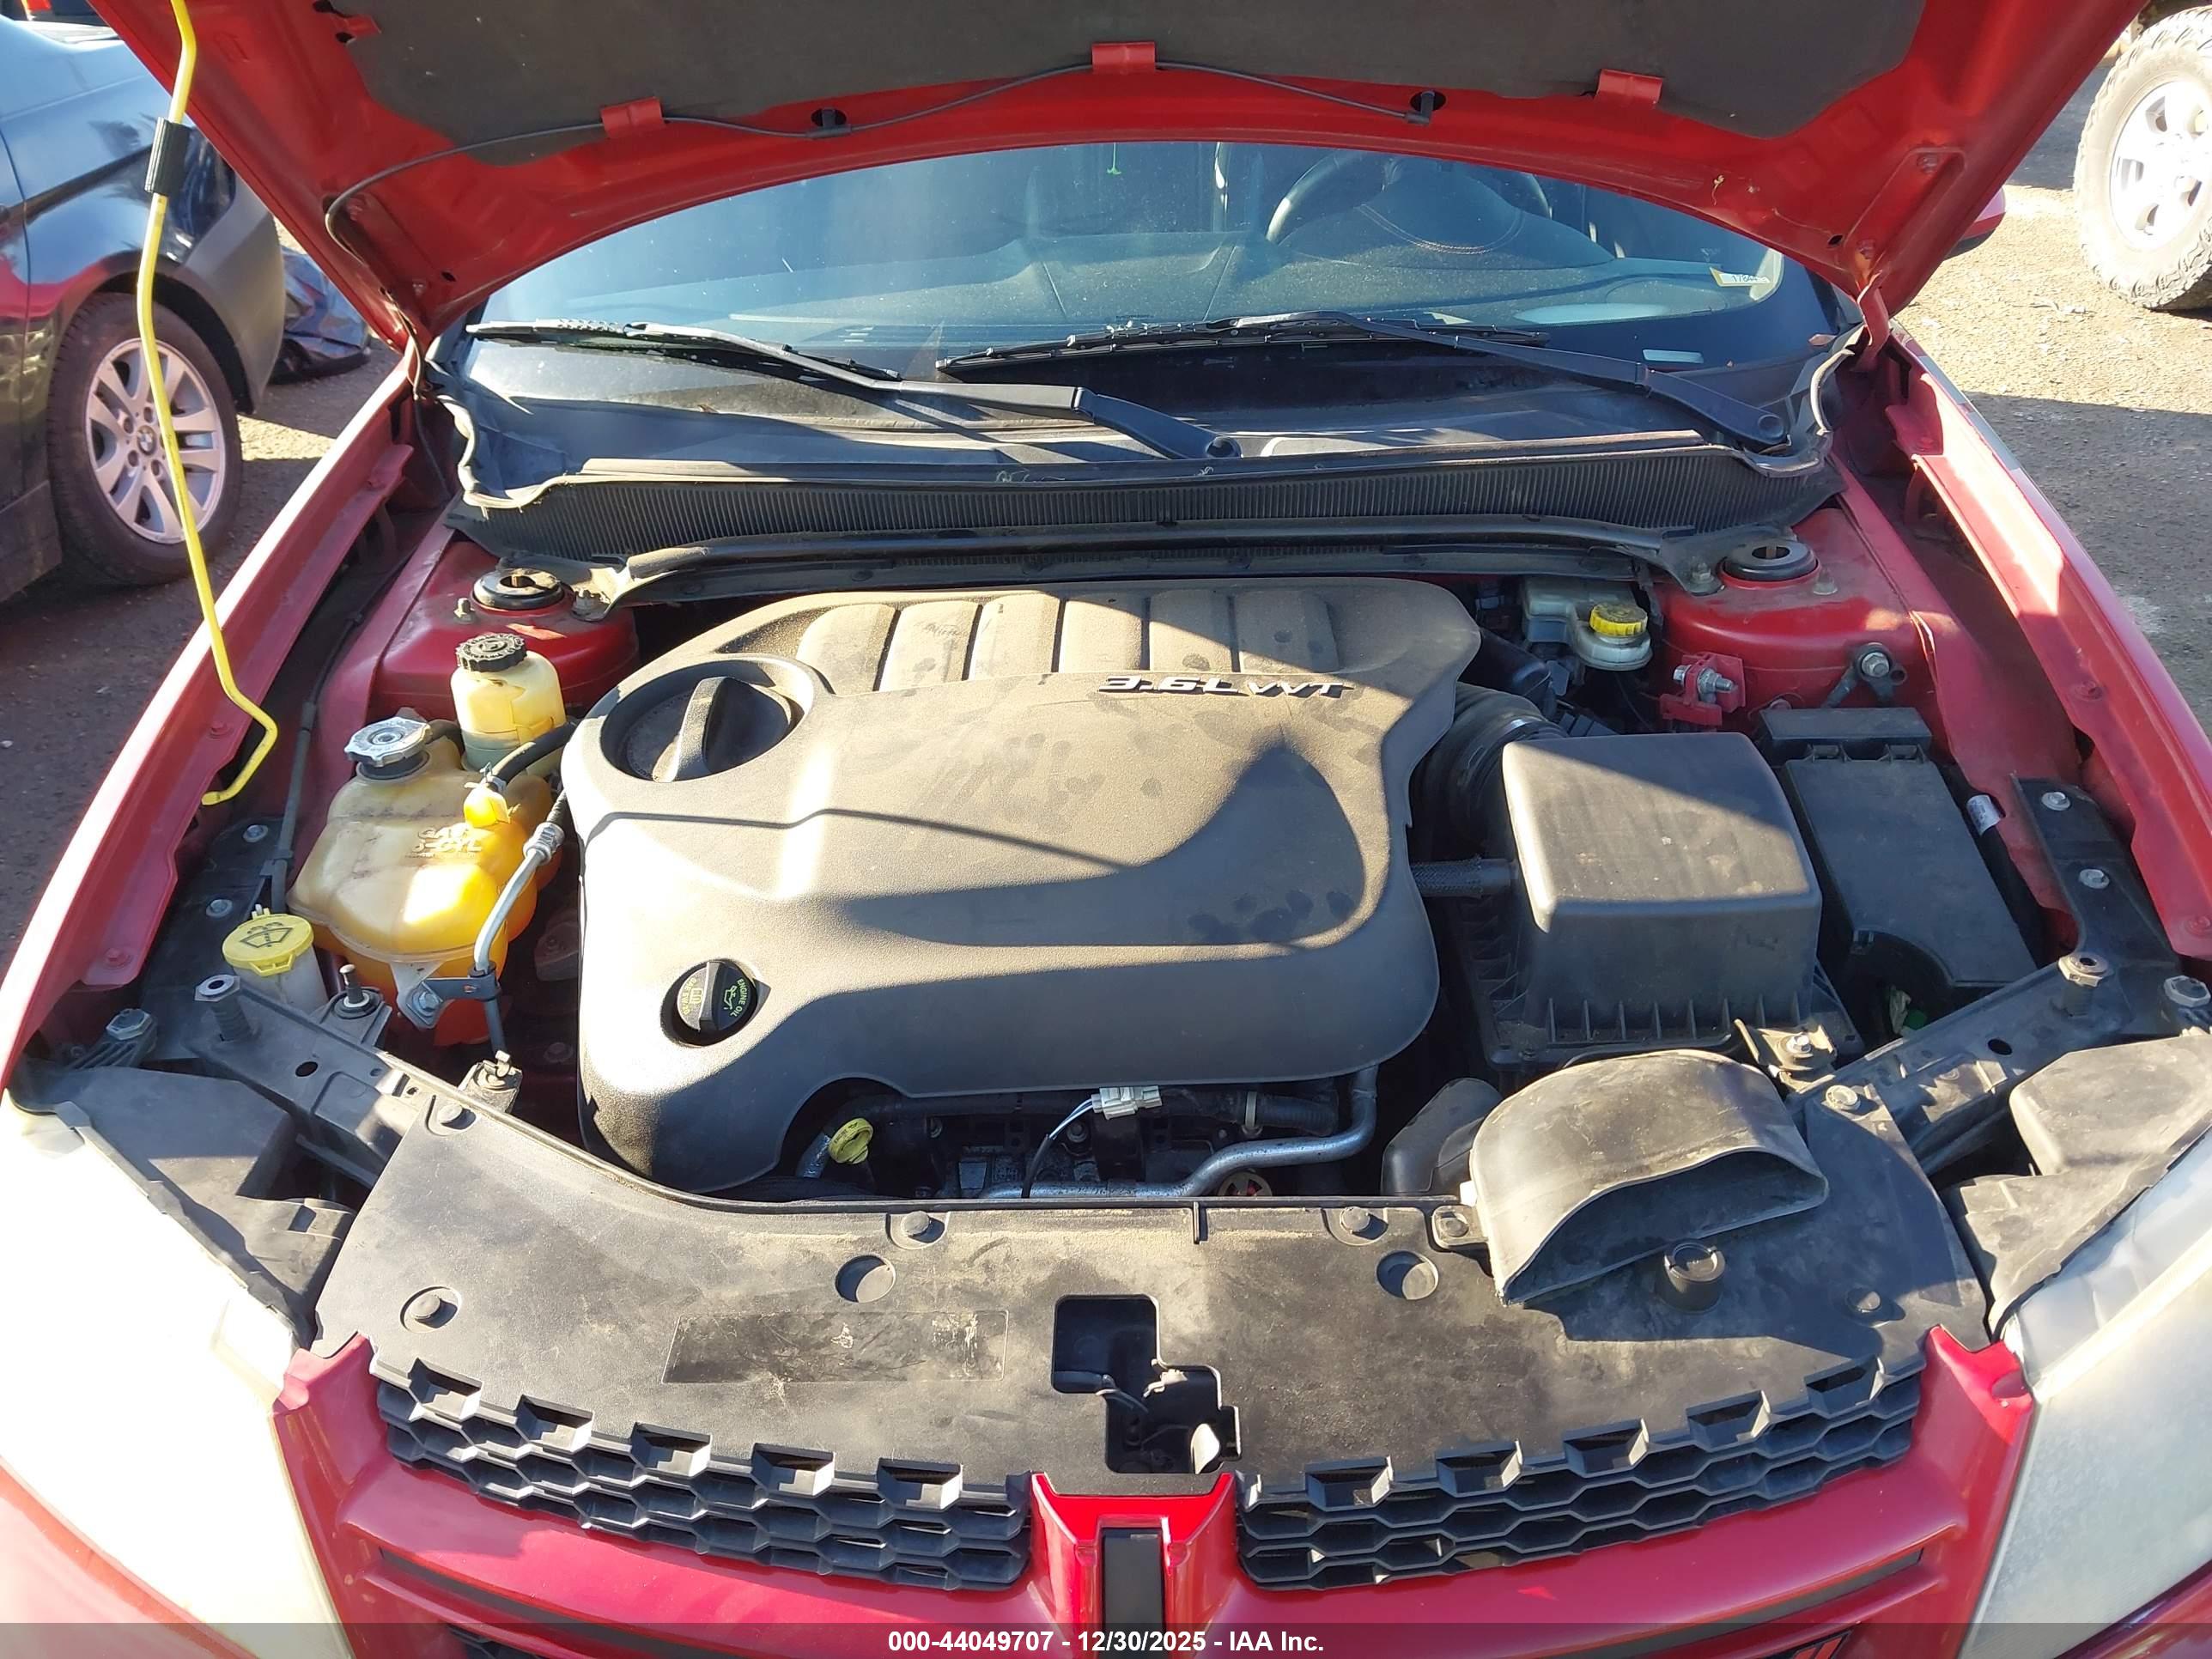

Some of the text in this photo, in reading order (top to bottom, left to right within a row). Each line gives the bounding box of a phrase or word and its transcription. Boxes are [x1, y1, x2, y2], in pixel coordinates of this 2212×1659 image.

[1098, 675, 1344, 696] 3.6L VVT
[730, 978, 749, 1018] ENGINE OIL
